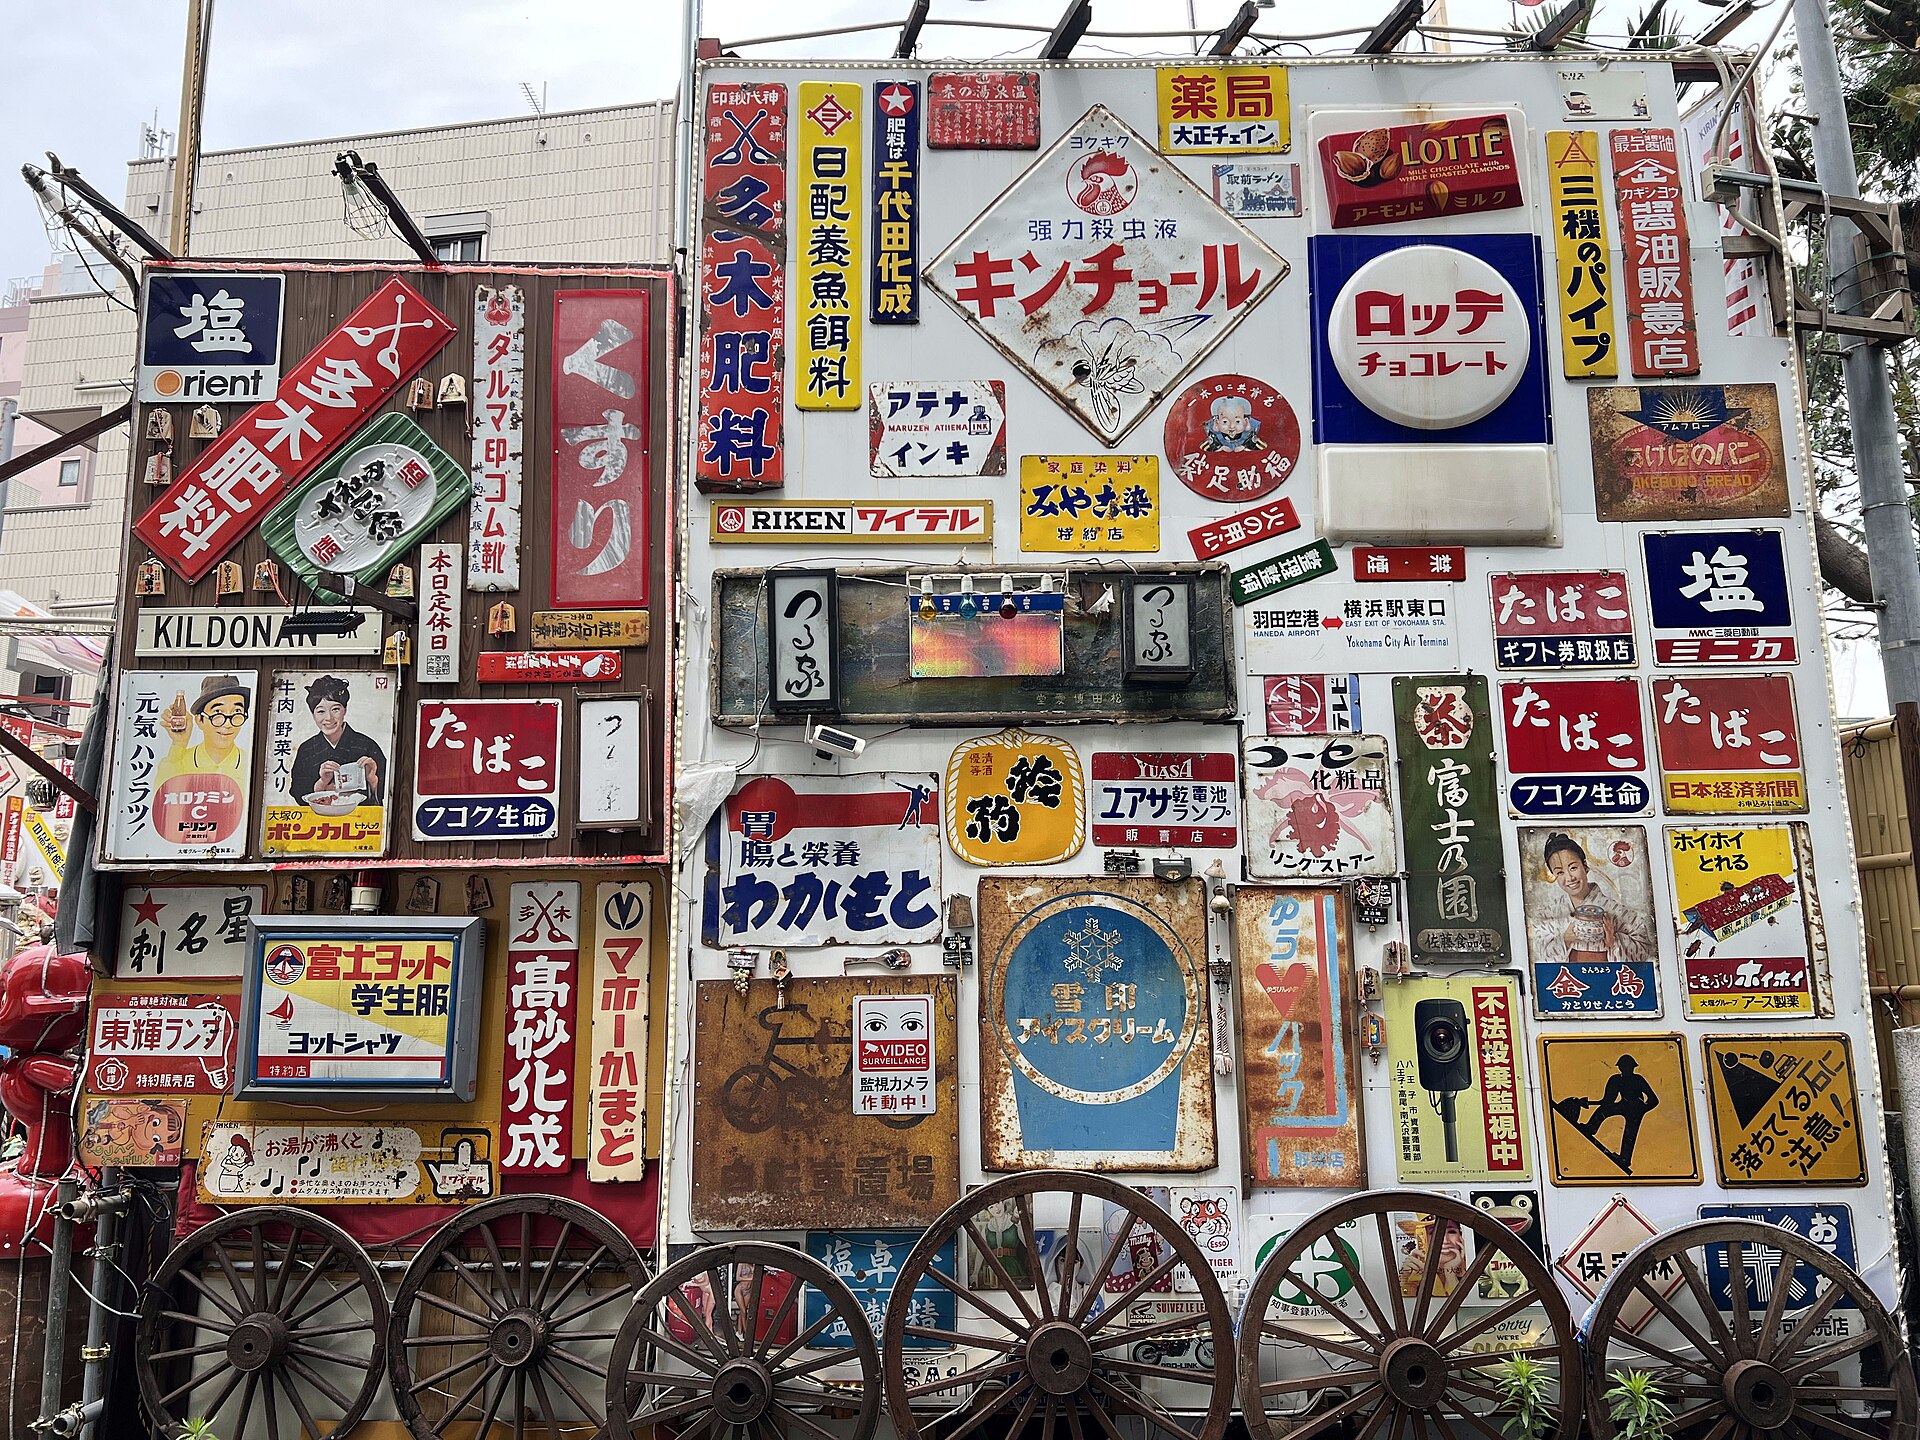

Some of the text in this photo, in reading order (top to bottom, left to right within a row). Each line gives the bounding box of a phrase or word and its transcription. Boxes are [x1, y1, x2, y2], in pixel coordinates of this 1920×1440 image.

[1171, 75, 1273, 119] 薬局
[886, 117, 907, 160] 肥料は
[1070, 136, 1129, 149] ヨクキク
[1174, 125, 1275, 146] 大正チェイン
[1401, 131, 1503, 166] LOTTE
[1399, 163, 1510, 182] WHOLE ROASTED ALMONDS
[1430, 162, 1479, 174] CHOCOLATE
[1483, 159, 1500, 167] with
[1352, 190, 1507, 221] アーモンド ミルク
[1621, 186, 1679, 200] カギショウ
[877, 161, 912, 314] 千代田化成
[808, 147, 852, 399] 日配養魚餌料
[954, 243, 1262, 319] キンチョール
[1560, 175, 1611, 367] 三機のパイプ
[173, 289, 252, 354] 塩
[704, 175, 776, 476] 多木肥料
[1355, 289, 1504, 337] ロッテ
[1358, 351, 1508, 377] チョコレート
[887, 391, 969, 419] アテナ
[888, 424, 930, 433] MARUZEN
[972, 424, 988, 432] INK
[1661, 422, 1710, 431] アムフロー
[160, 357, 374, 560] 多木肥料
[482, 331, 512, 574] ダルマ印ゴム靴
[561, 318, 642, 576] くすり
[888, 441, 970, 467] インキ
[1047, 460, 1132, 475] 家庭染料
[1633, 474, 1752, 489] AKEBONO BREAD
[752, 508, 980, 532] RIKEN ワイテル
[1202, 506, 1286, 551] 火の用心
[1057, 527, 1125, 542] 特約店
[1238, 548, 1324, 595] 整理整頓
[1679, 545, 1765, 612] 塩
[426, 549, 453, 651] 本日定休日
[1344, 599, 1446, 618] 横浜駅東口
[1499, 584, 1629, 625] たばこ
[1253, 610, 1319, 629] 羽田空港
[1393, 619, 1430, 627] YOKOHAMA
[1287, 629, 1320, 637] AIRPORT
[1346, 632, 1449, 649] Yokohama City Air Terminal
[1504, 639, 1629, 664] ギフト券取扱店
[1670, 639, 1782, 661] ミニカ
[133, 692, 160, 739] 元気
[1330, 677, 1351, 731] テレビ
[1512, 686, 1638, 768] たばこ
[1662, 682, 1792, 765] たばこ
[272, 680, 296, 793] 牛肉 野菜入り
[427, 707, 548, 791] たばこ
[1248, 738, 1386, 769] コーセー
[1134, 756, 1193, 779] YUASA
[1310, 769, 1386, 790] 化粧品
[164, 790, 235, 805] オロナミン
[1100, 784, 1228, 819] ユアサ 乾電池
[1518, 783, 1642, 807] フコク生命
[1669, 780, 1800, 799] 日本経済新聞
[191, 805, 208, 819] C
[268, 810, 302, 821] 大塚の
[424, 803, 548, 828] フコク生命
[741, 811, 776, 838] 胃
[1172, 806, 1232, 822] ランプ
[178, 822, 217, 832] ドリンク
[267, 823, 380, 841] ボンカレー
[1674, 831, 1745, 852] ホイホイ
[1269, 849, 1375, 873] リングストアー
[1698, 854, 1749, 872] とれる
[722, 869, 939, 935] わかもと
[306, 944, 451, 981] 富士ヨット
[1546, 964, 1645, 999] 金鳥
[1689, 960, 1804, 991] ごきぶりホイホイ
[352, 983, 450, 1016] 学生服
[1051, 982, 1137, 1013] 雪印
[1561, 1000, 1636, 1010] かとりせんこう
[1741, 995, 1800, 1009] アース製薬
[99, 1016, 222, 1051] 東輝ランプ
[1016, 1017, 1176, 1044] アイスクリーム
[288, 1033, 402, 1054] ヨットシャツ
[596, 938, 644, 1167] マホーかまど
[880, 1043, 926, 1056] VIDEO
[270, 1065, 307, 1077] 特約店
[862, 1057, 927, 1065] SURVEILLANCE
[136, 1074, 195, 1088] 特約販売店
[860, 1077, 928, 1092] 監視カメラ
[1478, 991, 1518, 1166] 不法投棄監視中
[1730, 1050, 1845, 1178] 落ちてくる石に
[265, 1132, 363, 1157] お湯が沸くと
[449, 1176, 485, 1184] ワイテル
[1209, 1258, 1234, 1266] TIGER
[1176, 1271, 1185, 1279] IN
[1156, 1302, 1184, 1313] SUIVEZ
[1186, 1302, 1195, 1312] LE
